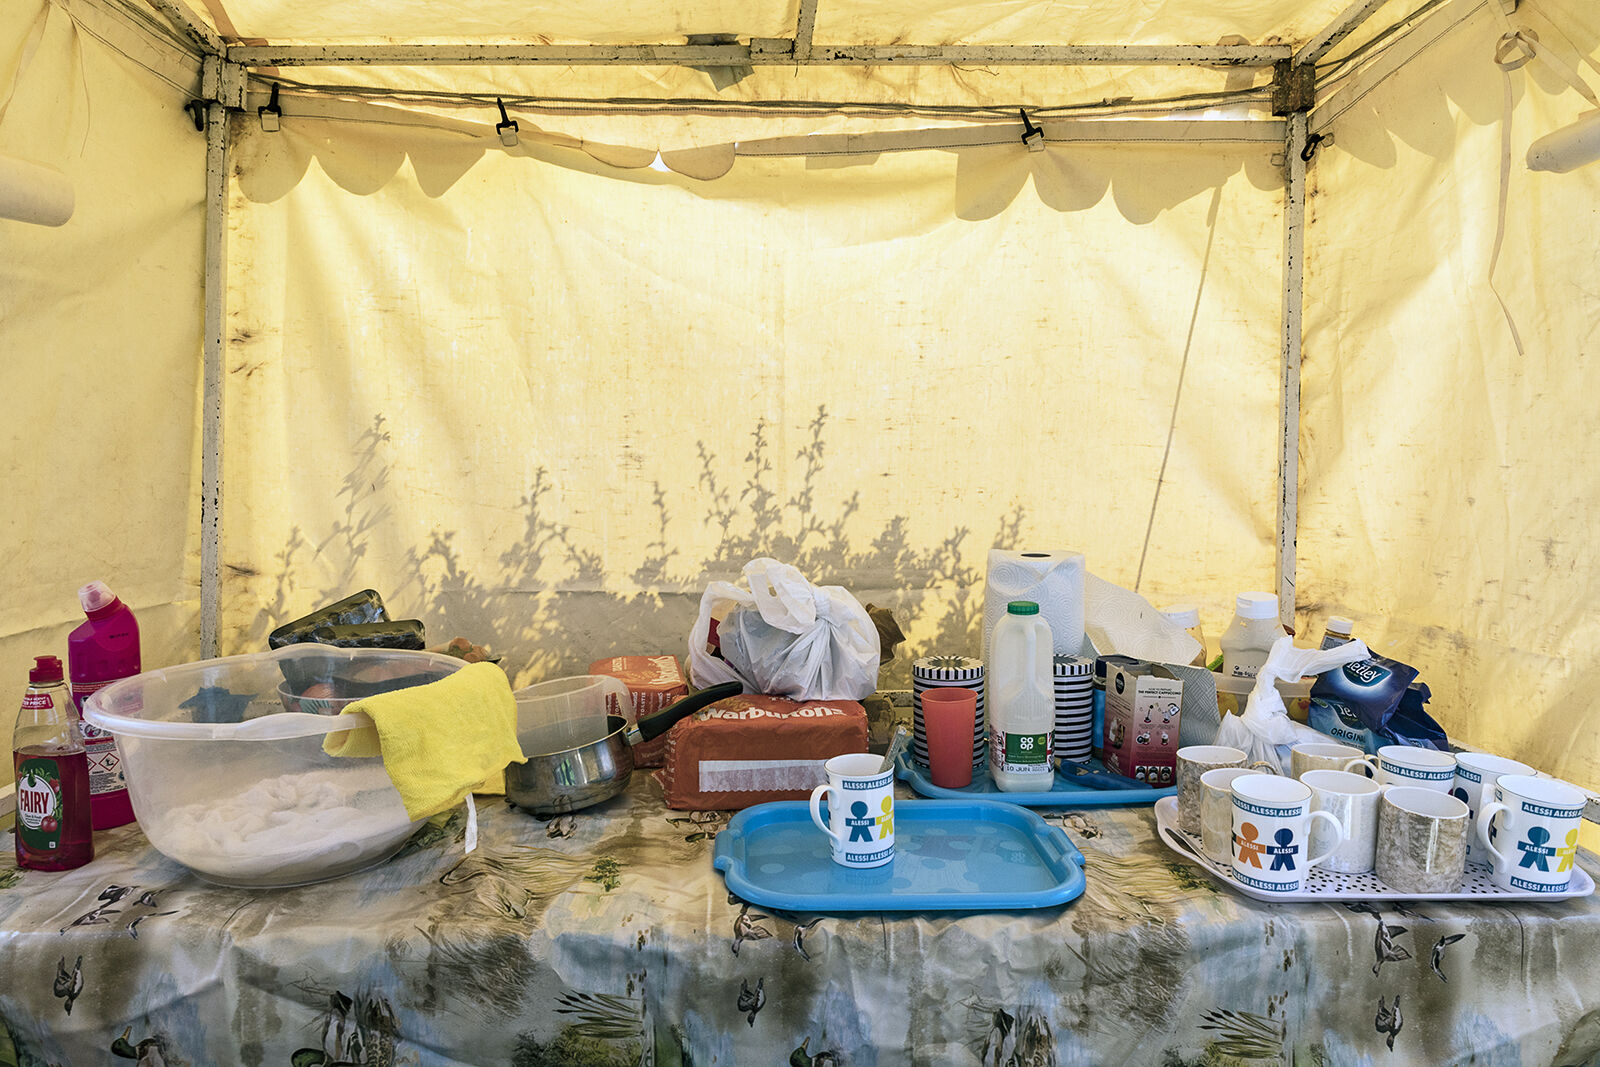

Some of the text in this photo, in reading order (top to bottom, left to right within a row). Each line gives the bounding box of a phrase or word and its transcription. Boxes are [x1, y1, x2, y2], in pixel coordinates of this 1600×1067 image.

[700, 705, 849, 722] Warburtons
[1400, 768, 1427, 779] ALESSI
[1427, 772, 1449, 780] ALESSI
[844, 781, 867, 790] ALESSI
[867, 777, 888, 789] ALESSI
[20, 789, 50, 814] FAIRY
[1250, 805, 1278, 816] ALESSI
[1279, 807, 1302, 817] ALESSI
[1523, 803, 1553, 816] ALESSI
[1553, 809, 1578, 818] ALESSI
[1241, 839, 1259, 851] ALESSI
[1525, 844, 1549, 855] ALESSI
[847, 853, 869, 862] ALESSI
[870, 848, 889, 861] ALESSI
[1250, 878, 1275, 890] ALESSI
[1276, 882, 1299, 890] ALESSI
[1511, 878, 1541, 891] ALESSI
[1542, 883, 1565, 892] ALESSI
